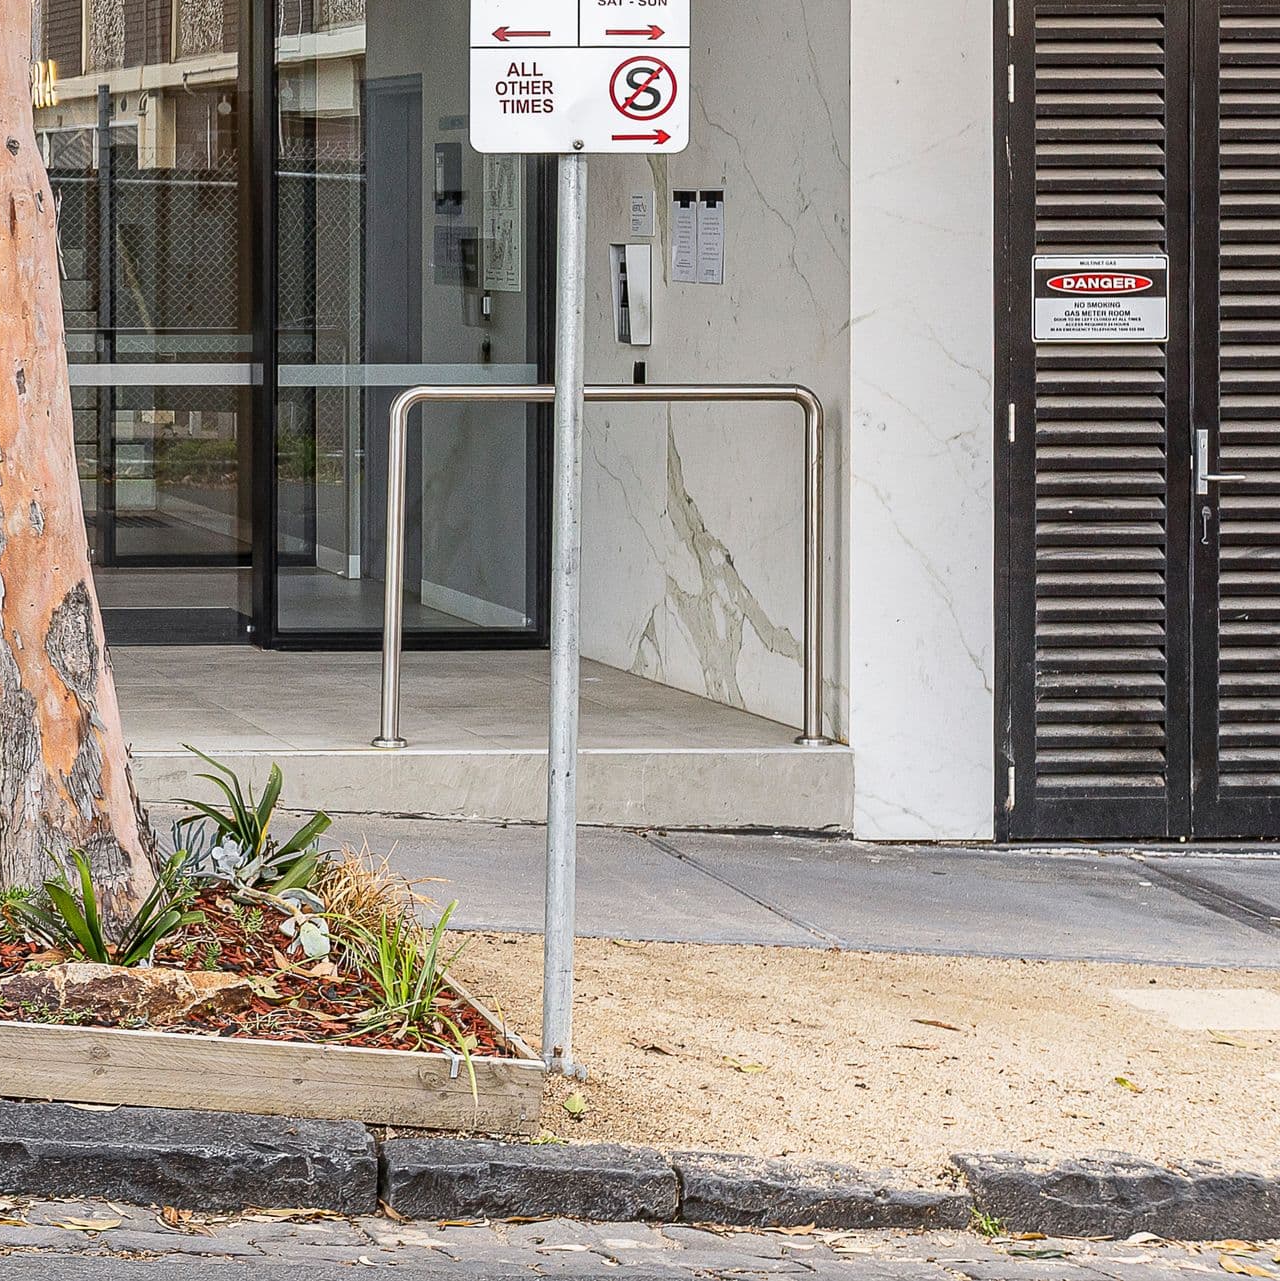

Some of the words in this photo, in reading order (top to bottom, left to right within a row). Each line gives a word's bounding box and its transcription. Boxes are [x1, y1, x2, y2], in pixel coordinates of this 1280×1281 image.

[506, 62, 543, 78] ALL
[495, 80, 554, 96] OTHER
[499, 99, 554, 114] TIMES
[1062, 277, 1136, 289] DANGER
